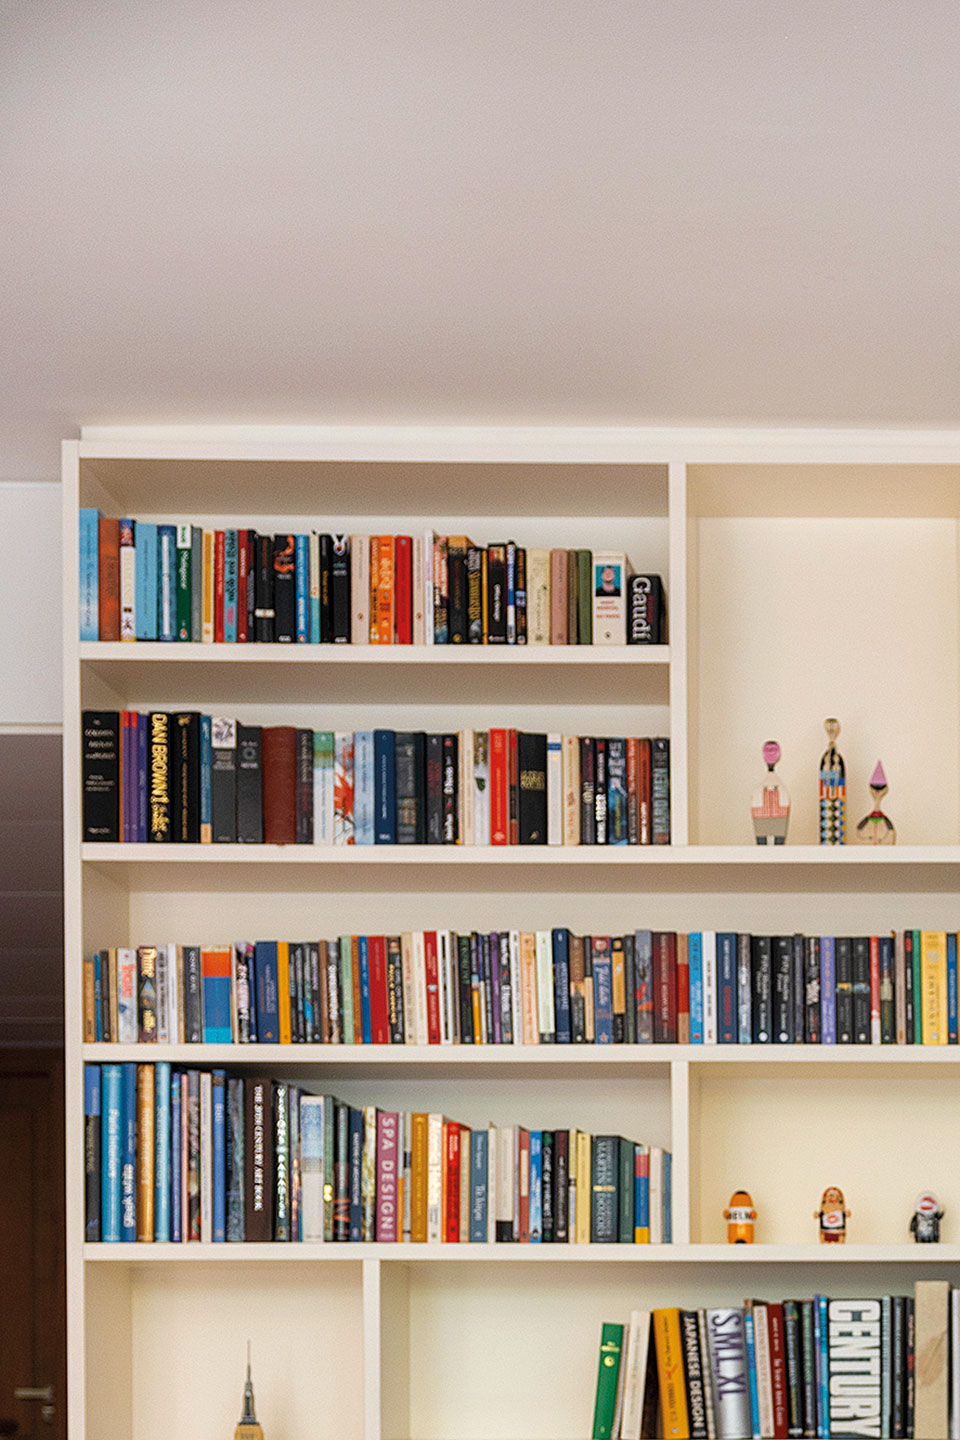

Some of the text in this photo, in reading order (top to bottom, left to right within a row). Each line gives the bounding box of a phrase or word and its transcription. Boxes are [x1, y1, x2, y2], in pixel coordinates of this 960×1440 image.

[632, 577, 652, 640] Gaudí
[151, 713, 168, 744] DAN
[151, 744, 168, 796] BROWN
[653, 768, 669, 798] MEN
[254, 1085, 263, 1211] THE 20TH CENTURY ART BOOK
[381, 1117, 395, 1230] SPA DESIGN
[429, 1119, 441, 1208] Atomic Habits
[684, 1316, 704, 1428] JAPANESE DESIGN
[711, 1313, 746, 1401] S,M,L,XL
[829, 1300, 881, 1438] CENTURY
